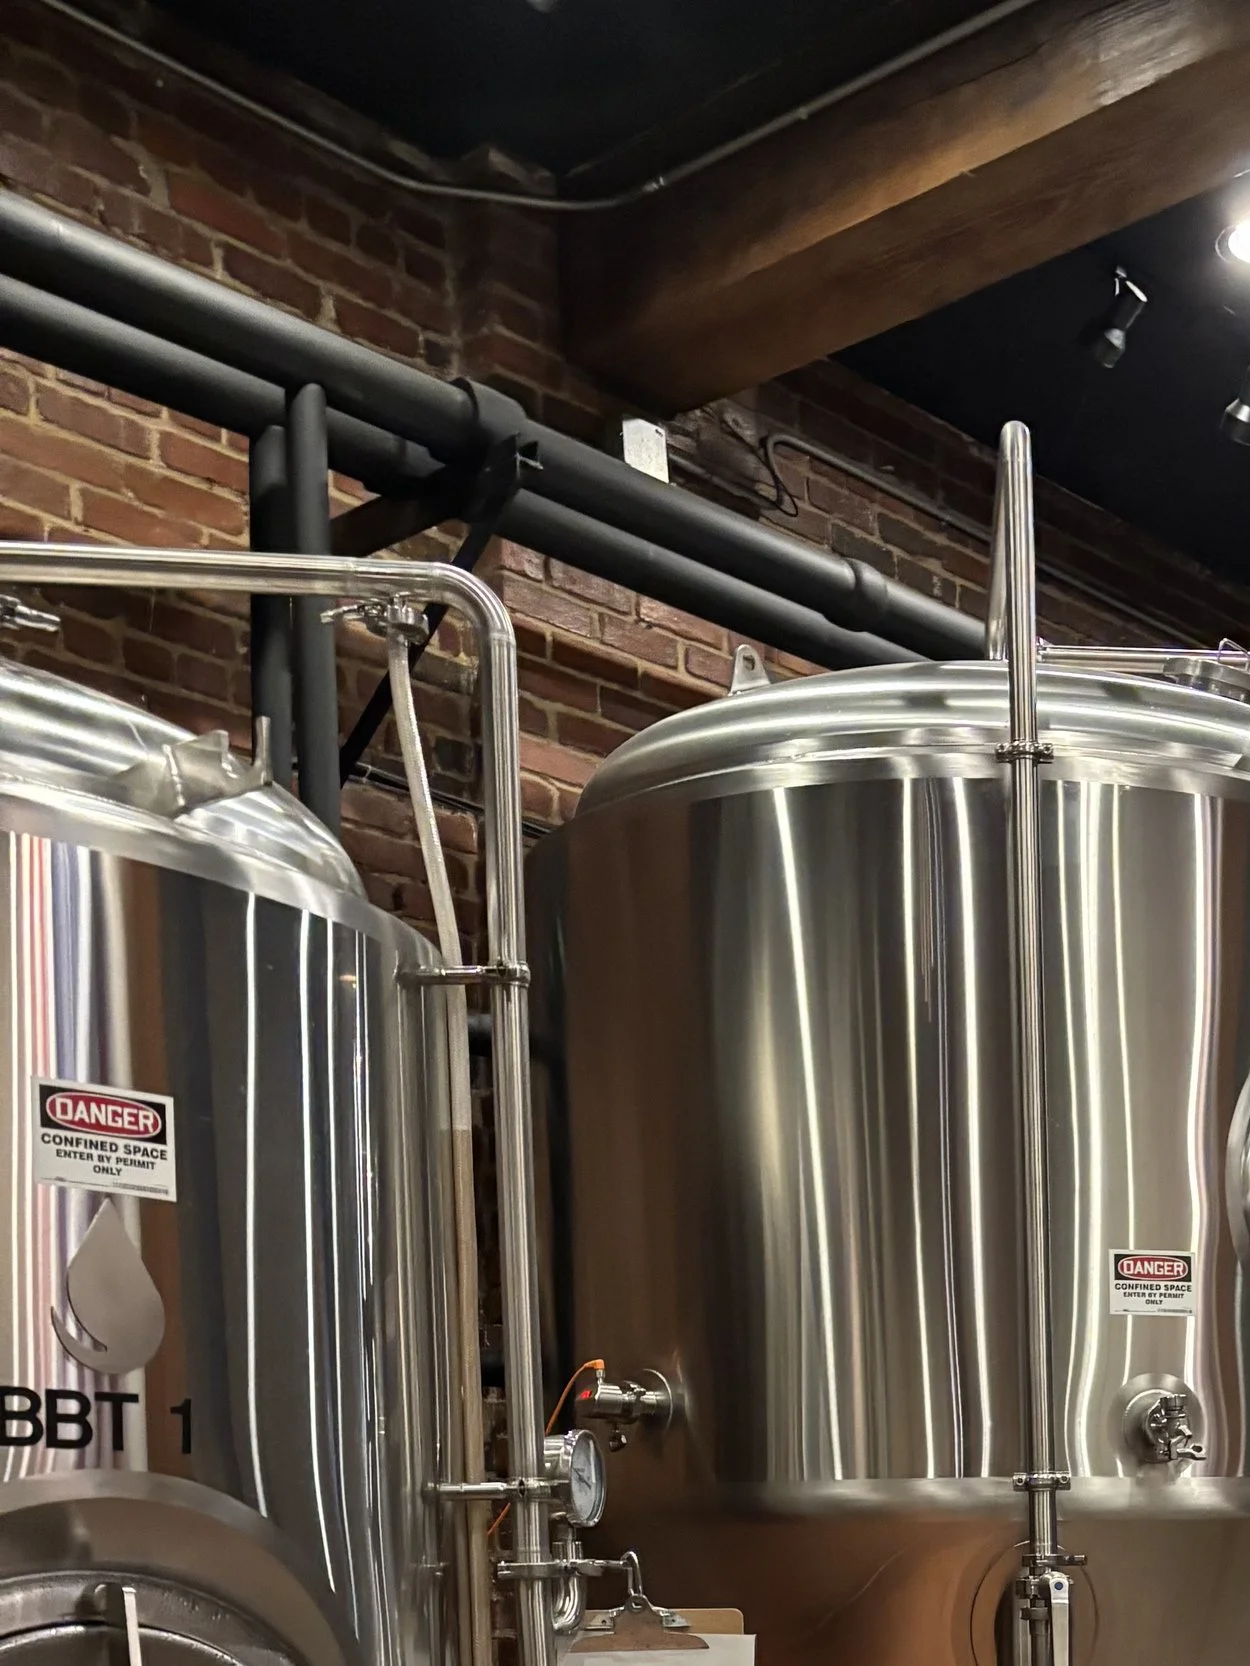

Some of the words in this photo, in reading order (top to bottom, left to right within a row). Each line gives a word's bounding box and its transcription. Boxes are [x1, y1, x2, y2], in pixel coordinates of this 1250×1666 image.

[54, 1097, 154, 1132] DANGER
[41, 1132, 118, 1153] CONFINED
[124, 1144, 168, 1161] SPACE
[56, 1148, 94, 1162] ENTER
[97, 1154, 112, 1164] BY
[115, 1157, 156, 1171] PERMIT
[93, 1164, 122, 1177] ONLY
[1123, 1260, 1184, 1276] DANGER
[1114, 1282, 1161, 1291] CONFINED
[1163, 1284, 1192, 1292] SPACE
[0, 1385, 139, 1452] BBT
[170, 1398, 192, 1455] 1
